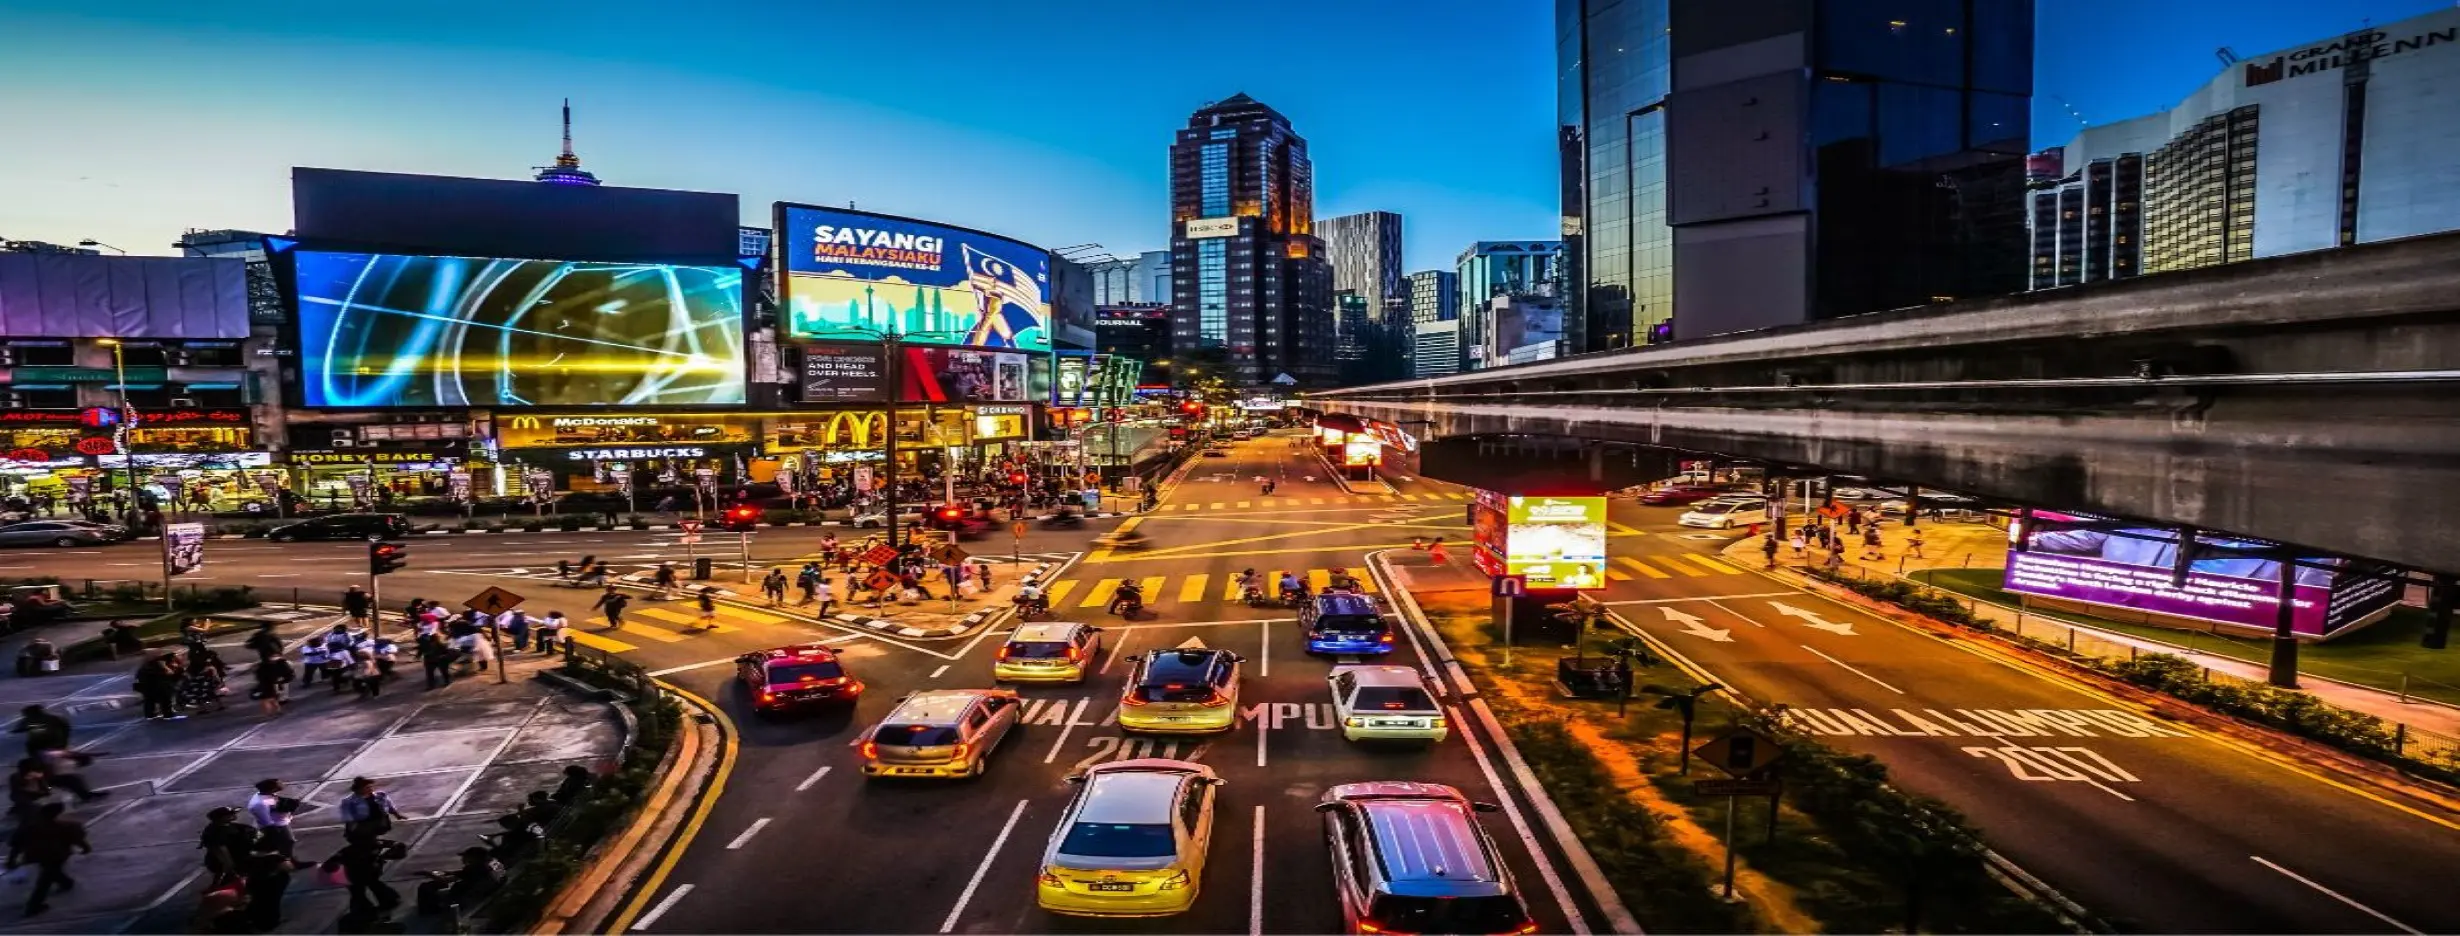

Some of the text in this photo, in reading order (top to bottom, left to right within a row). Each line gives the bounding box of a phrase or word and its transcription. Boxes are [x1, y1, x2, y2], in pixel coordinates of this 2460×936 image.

[815, 225, 944, 253] SAYANGI
[815, 243, 942, 265] MALAYSIAKU
[554, 417, 658, 427] McDonald's
[291, 453, 434, 462] HONEY BAKE
[568, 448, 704, 460] STARBUCKS
[1960, 747, 2143, 782] 2017
